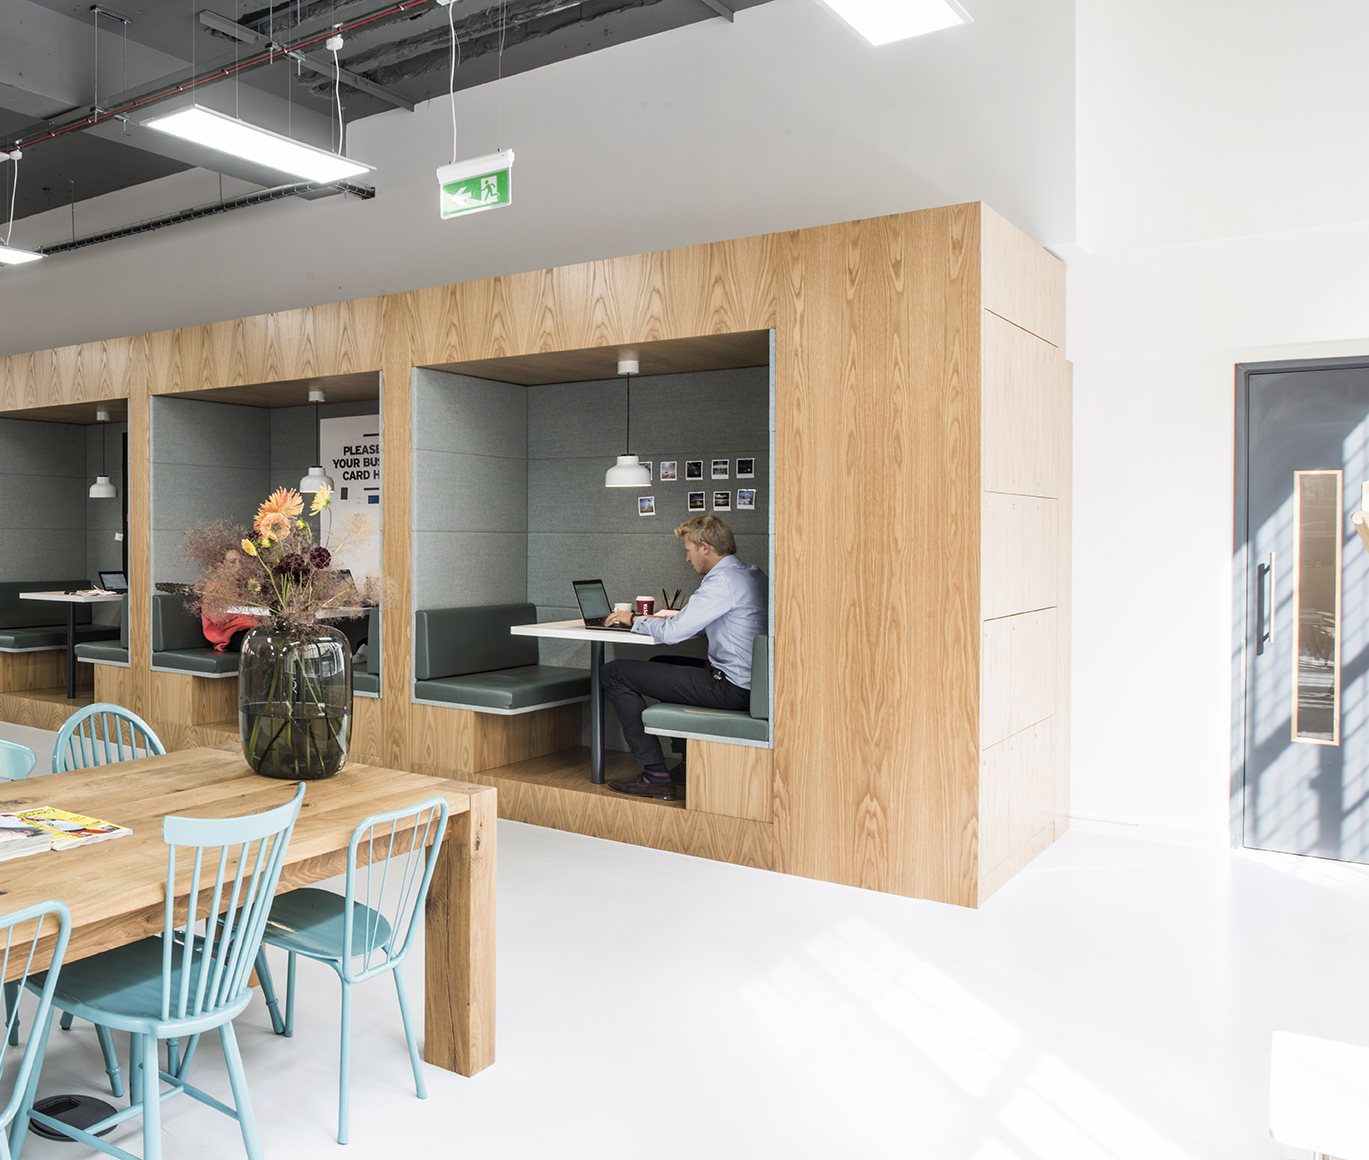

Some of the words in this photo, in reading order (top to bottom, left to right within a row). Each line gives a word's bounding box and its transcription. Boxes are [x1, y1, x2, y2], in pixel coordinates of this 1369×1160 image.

[343, 444, 379, 456] PLEASE
[332, 458, 360, 468] YOUR
[342, 470, 370, 480] CARD
